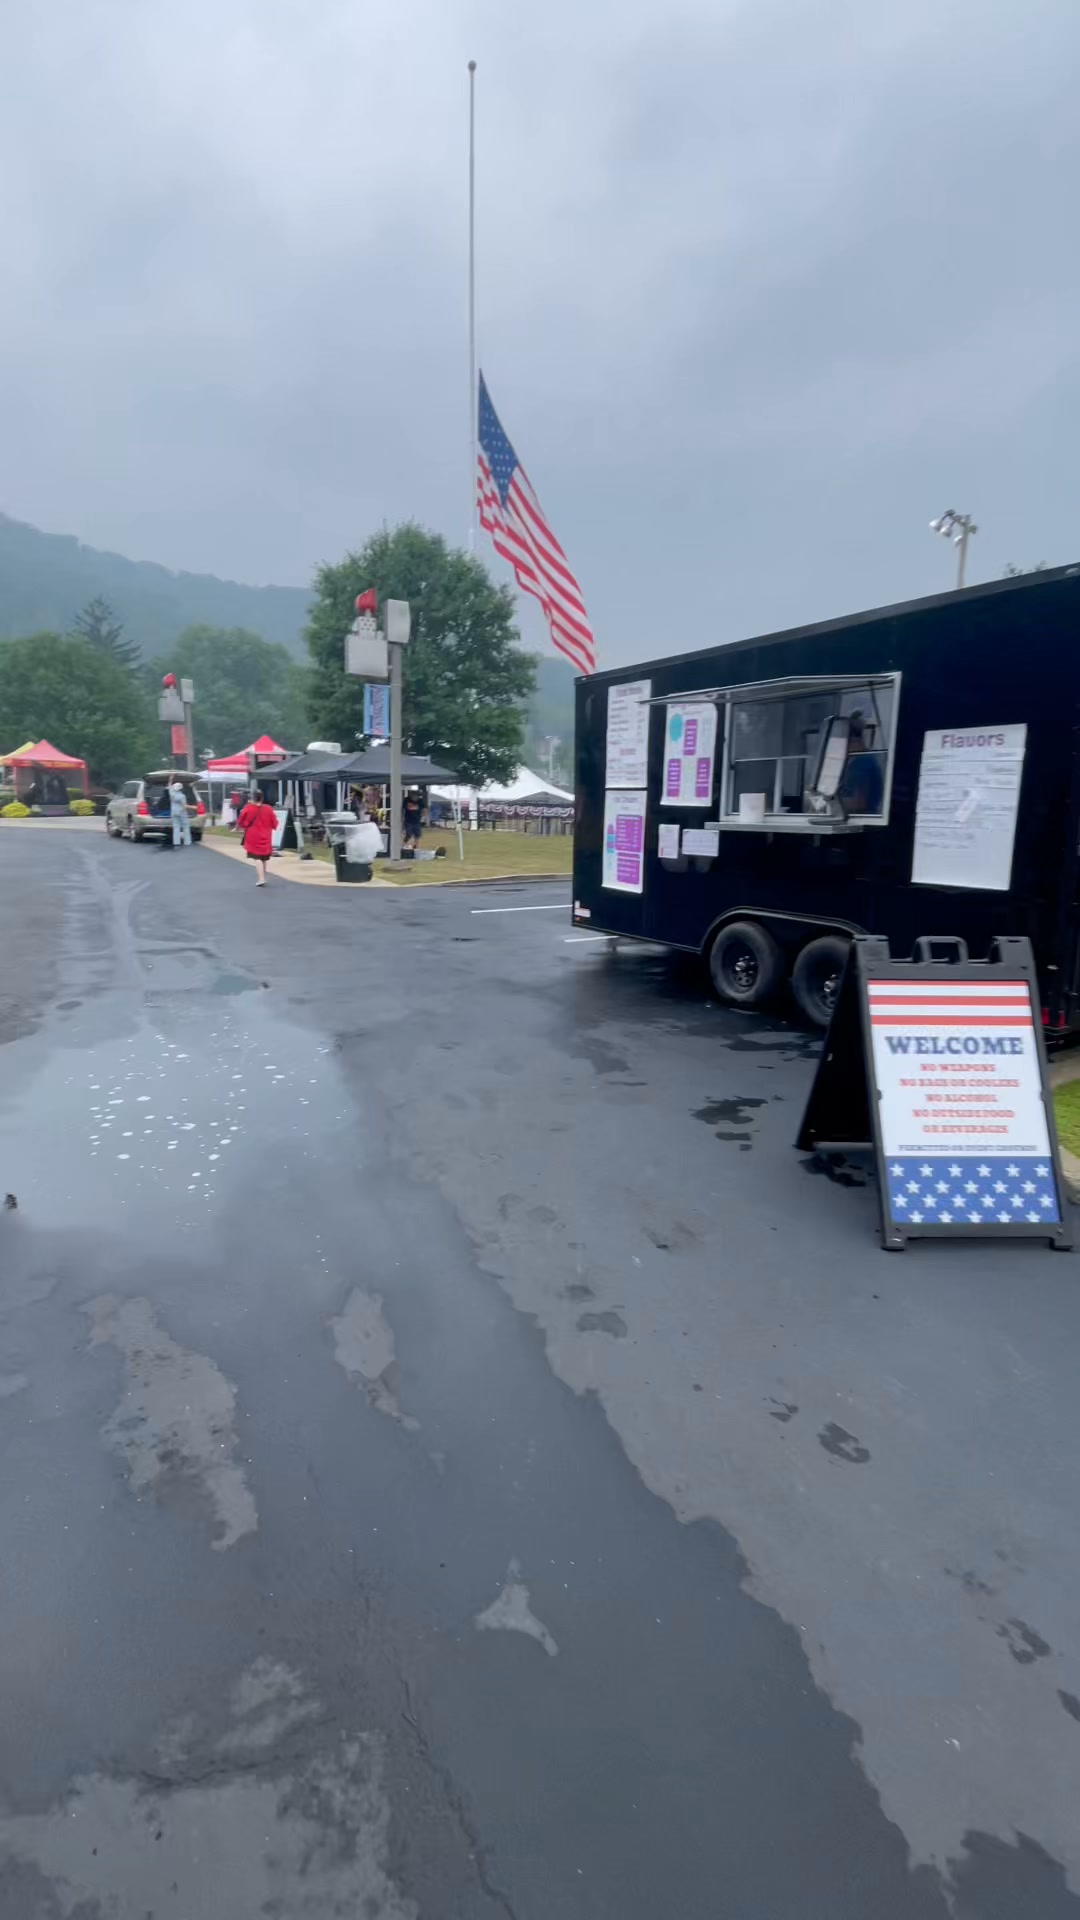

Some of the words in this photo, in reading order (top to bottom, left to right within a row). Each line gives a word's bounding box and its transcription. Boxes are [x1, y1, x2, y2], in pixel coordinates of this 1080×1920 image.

[885, 1036, 1023, 1055] WELCOME
[921, 1064, 936, 1072] NO
[939, 1064, 995, 1072] WEAPONS
[900, 1079, 917, 1087] NO
[969, 1079, 1018, 1087] COOLERS
[926, 1094, 943, 1102] NO
[945, 1094, 998, 1102] ALCOHOL
[913, 1109, 930, 1118] NO
[932, 1109, 981, 1118] OUTSIDE
[983, 1110, 1015, 1118] FOOD
[923, 1125, 940, 1133] OR
[941, 1125, 1008, 1134] BEVERAGES
